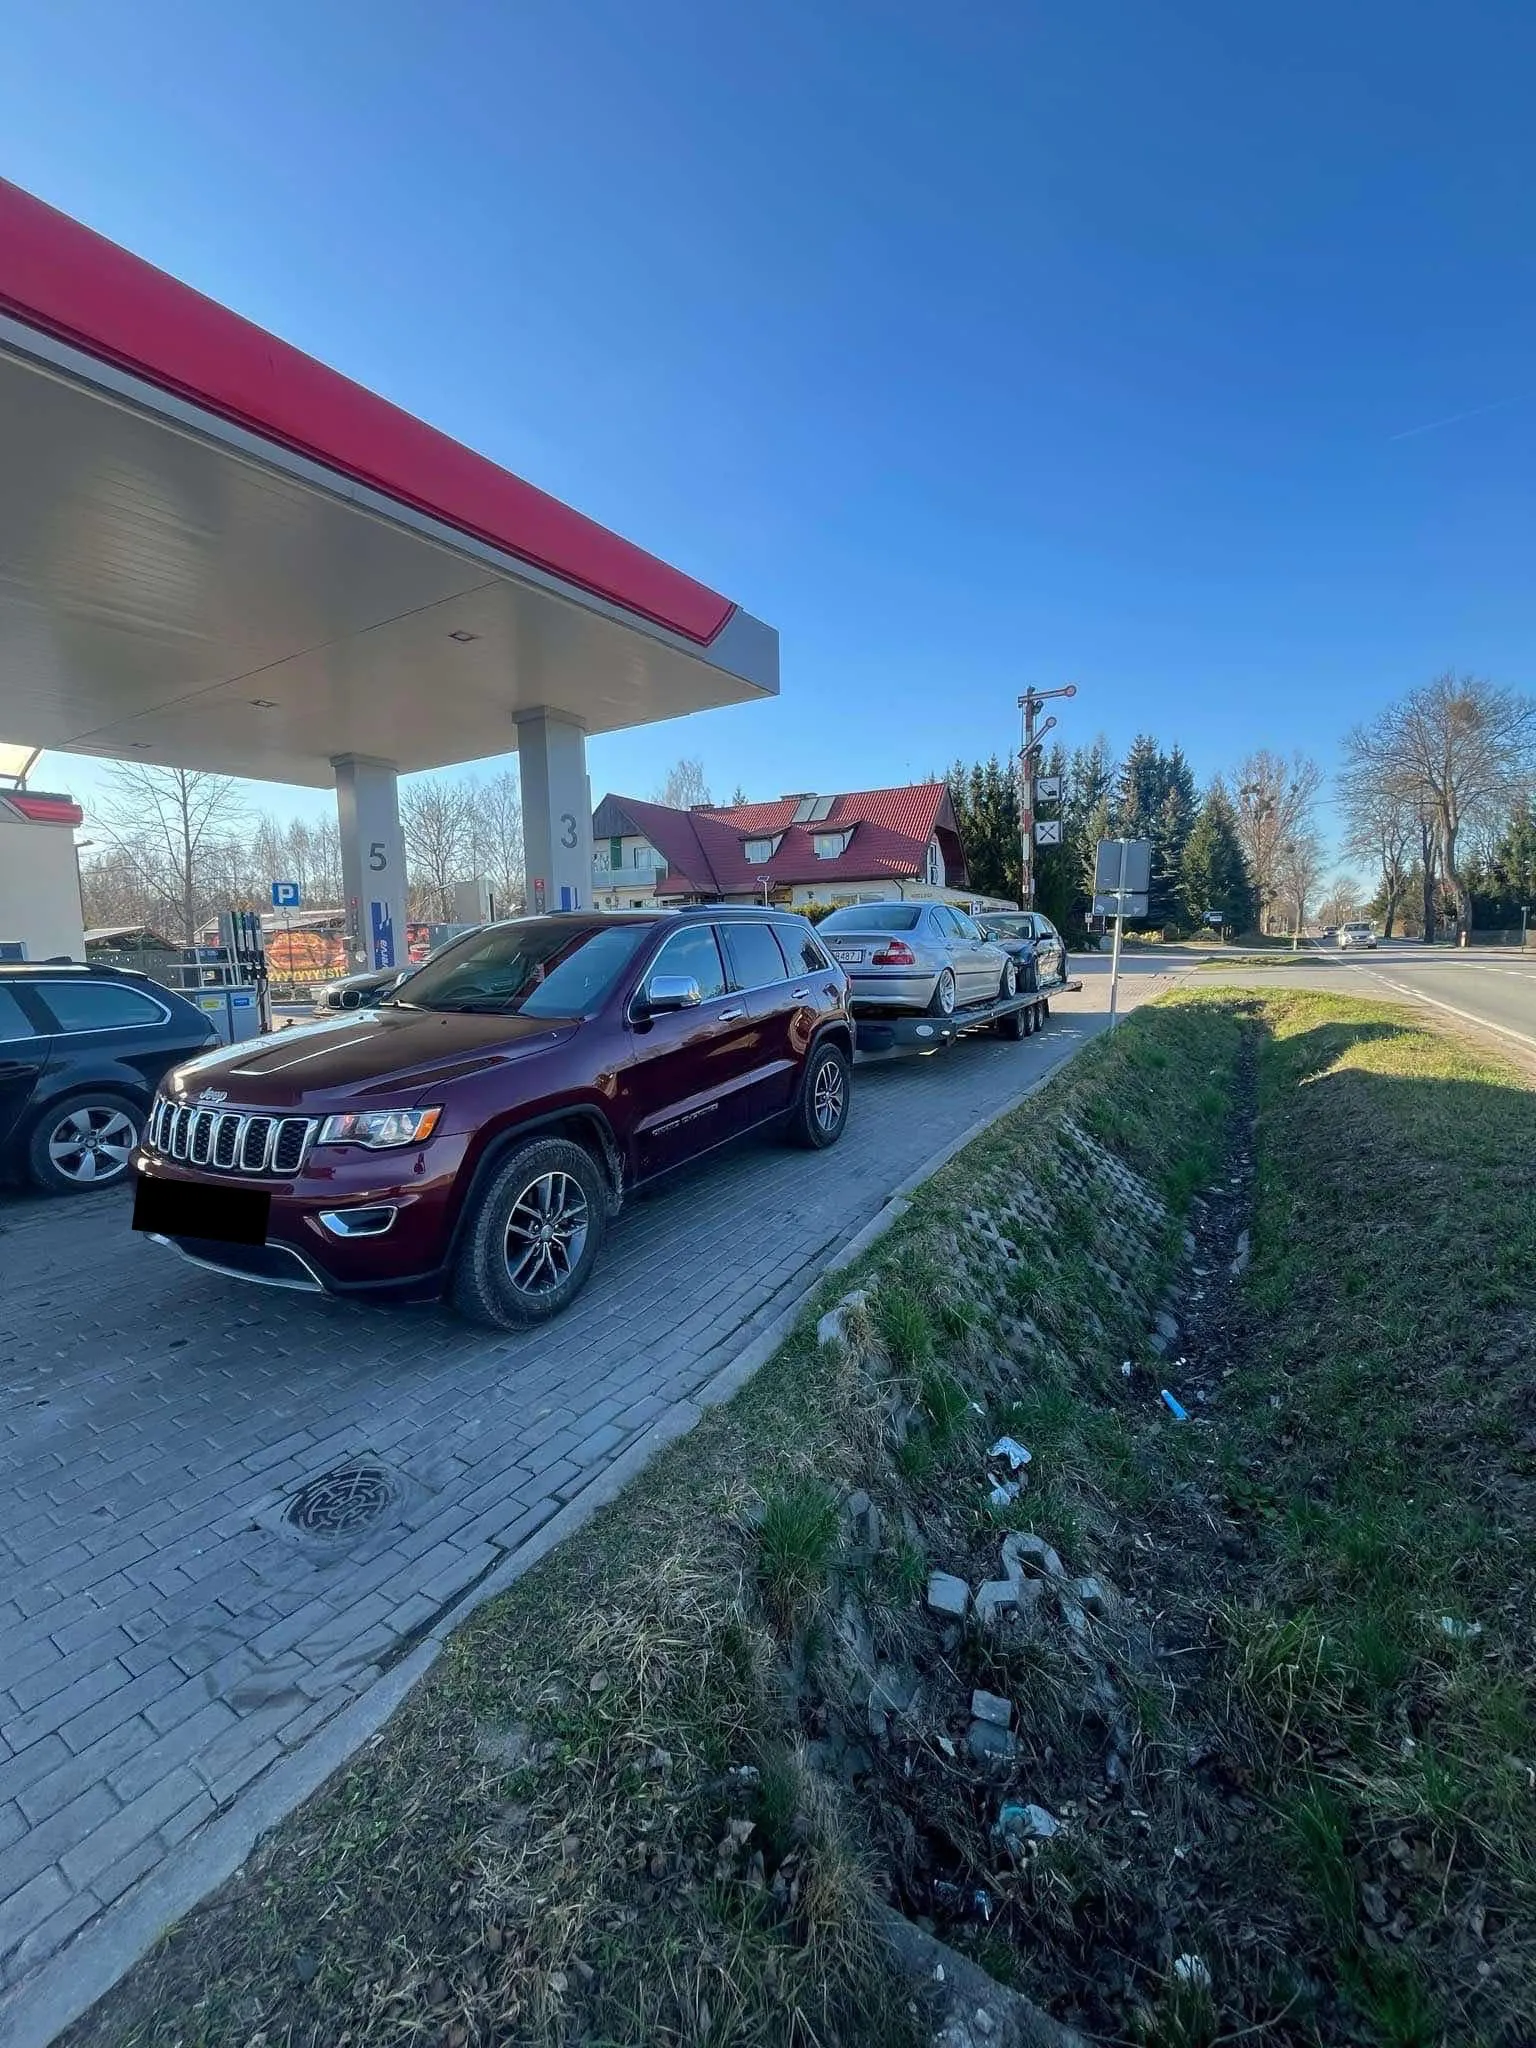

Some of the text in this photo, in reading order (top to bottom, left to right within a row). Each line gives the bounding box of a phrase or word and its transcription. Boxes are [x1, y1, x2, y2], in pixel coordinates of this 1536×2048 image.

[560, 813, 578, 849] 3
[369, 843, 387, 871] 5
[278, 885, 294, 903] P
[199, 1086, 228, 1104] Jeep
